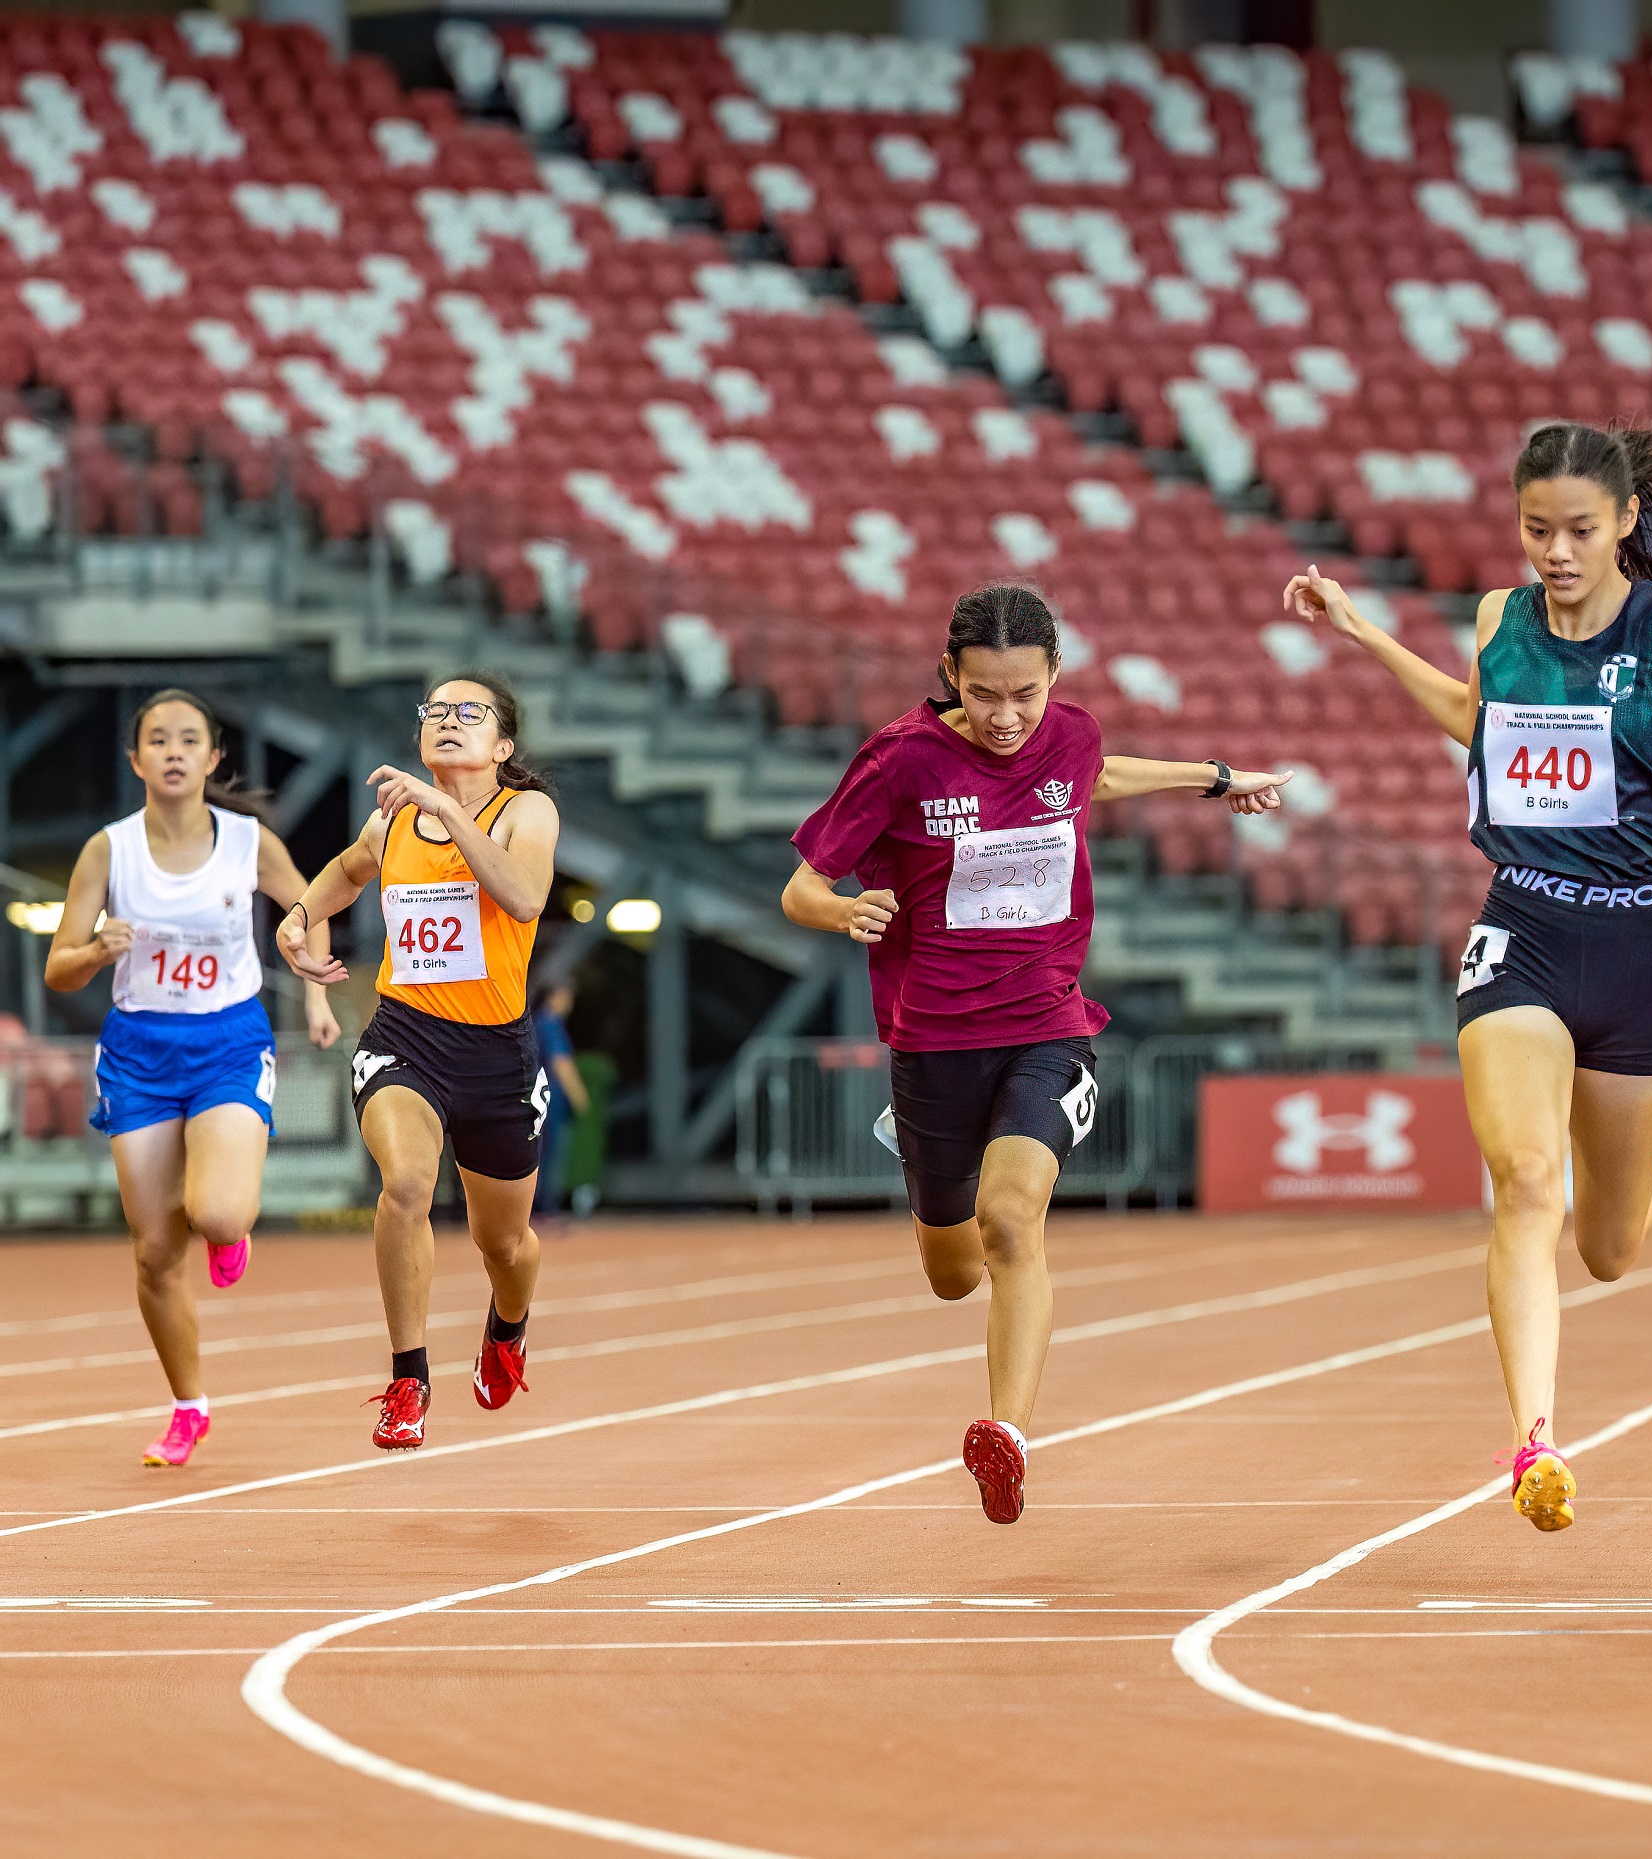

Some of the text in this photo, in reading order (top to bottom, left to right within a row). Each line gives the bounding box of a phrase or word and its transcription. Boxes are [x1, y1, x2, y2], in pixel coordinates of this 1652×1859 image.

[1507, 746, 1592, 791] 440
[921, 796, 980, 817] TEAM
[1526, 797, 1569, 809] B Girls
[925, 816, 981, 836] ODAC
[984, 842, 1012, 851] NATIONAL
[1021, 841, 1067, 853] CHAMPIONSHIPS
[968, 858, 1051, 893] 528
[1500, 865, 1582, 903] NIKE
[980, 905, 1028, 920] B Girls
[398, 917, 464, 954] 462
[151, 949, 218, 990] 149
[412, 958, 447, 969] B Girls
[1075, 1082, 1097, 1127] 5
